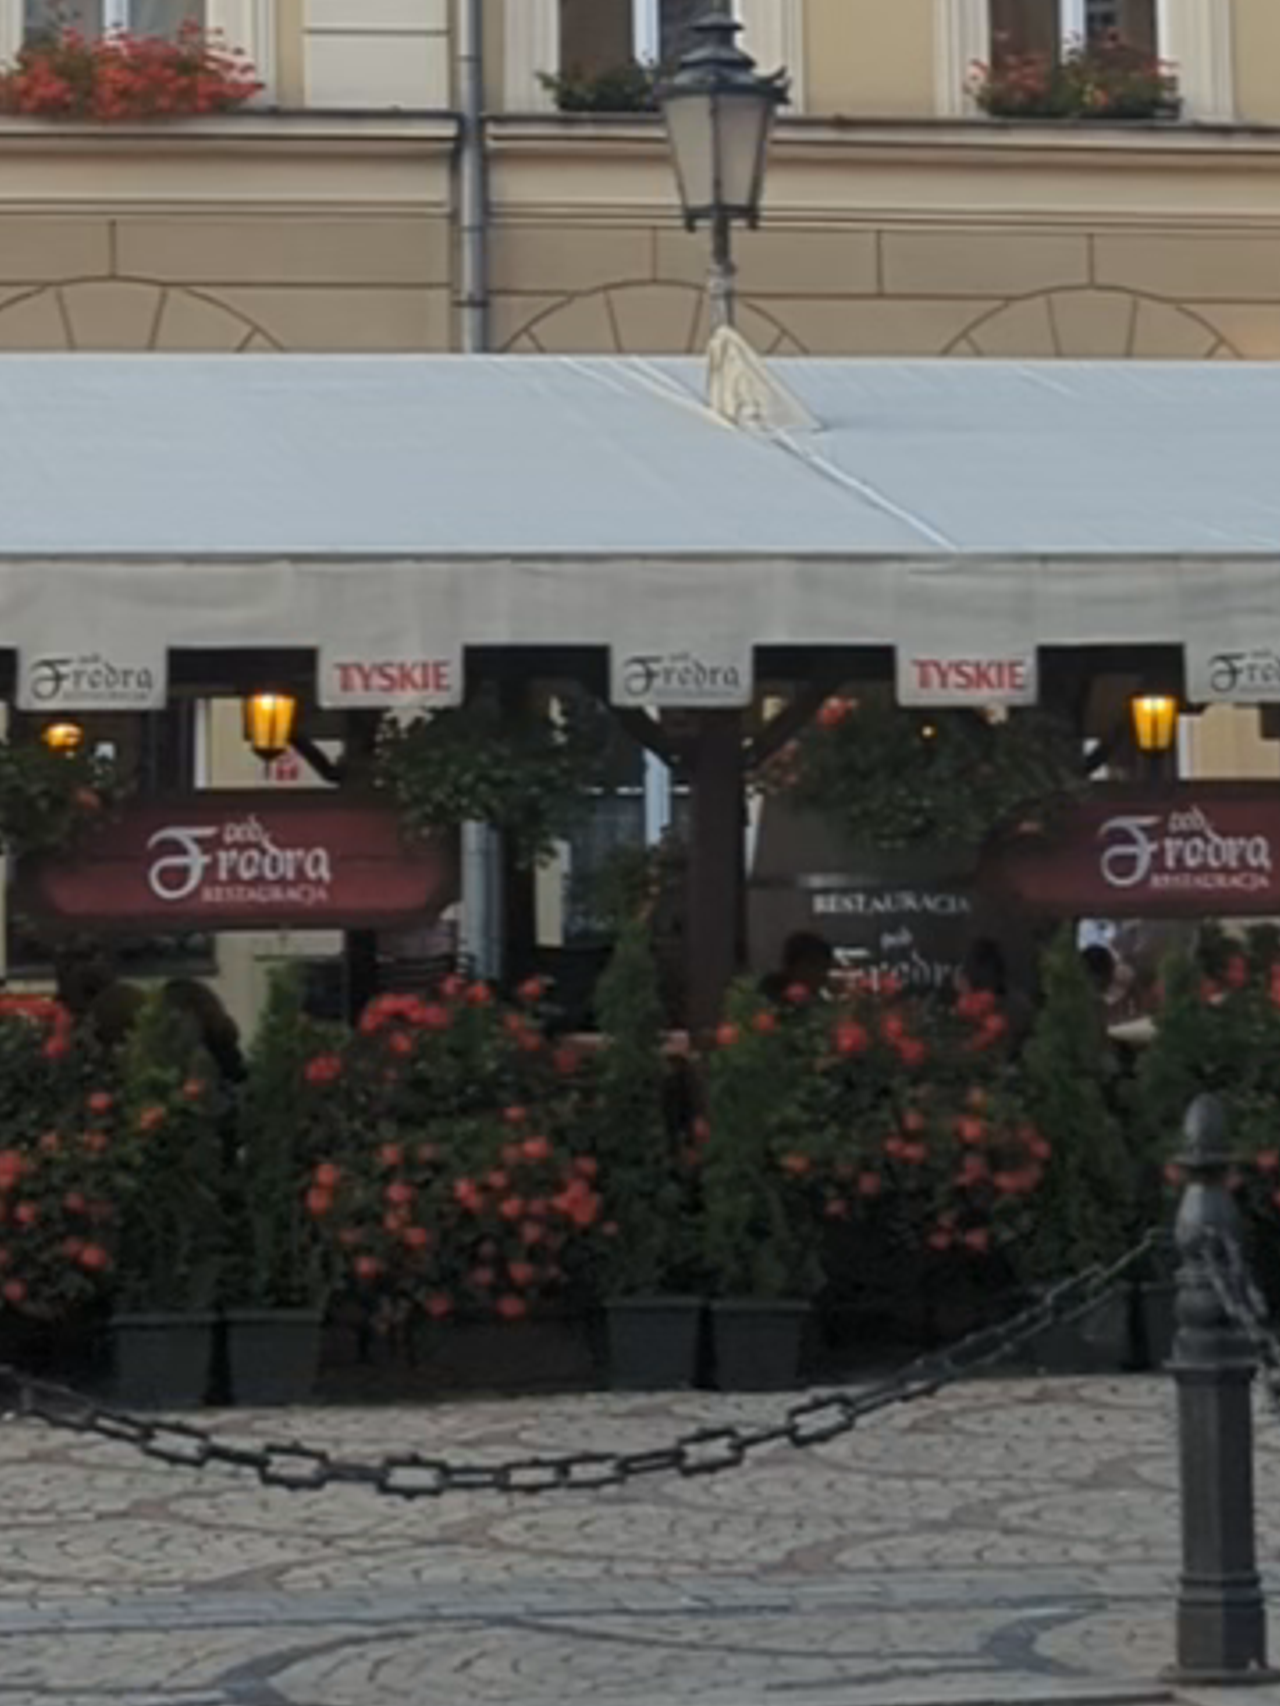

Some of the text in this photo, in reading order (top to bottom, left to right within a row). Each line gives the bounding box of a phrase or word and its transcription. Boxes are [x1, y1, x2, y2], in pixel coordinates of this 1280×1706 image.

[334, 660, 452, 694] TYSKIE
[911, 659, 1025, 690] TYSKIE
[146, 825, 332, 901] Fredra
[1096, 814, 1273, 888] Fredra
